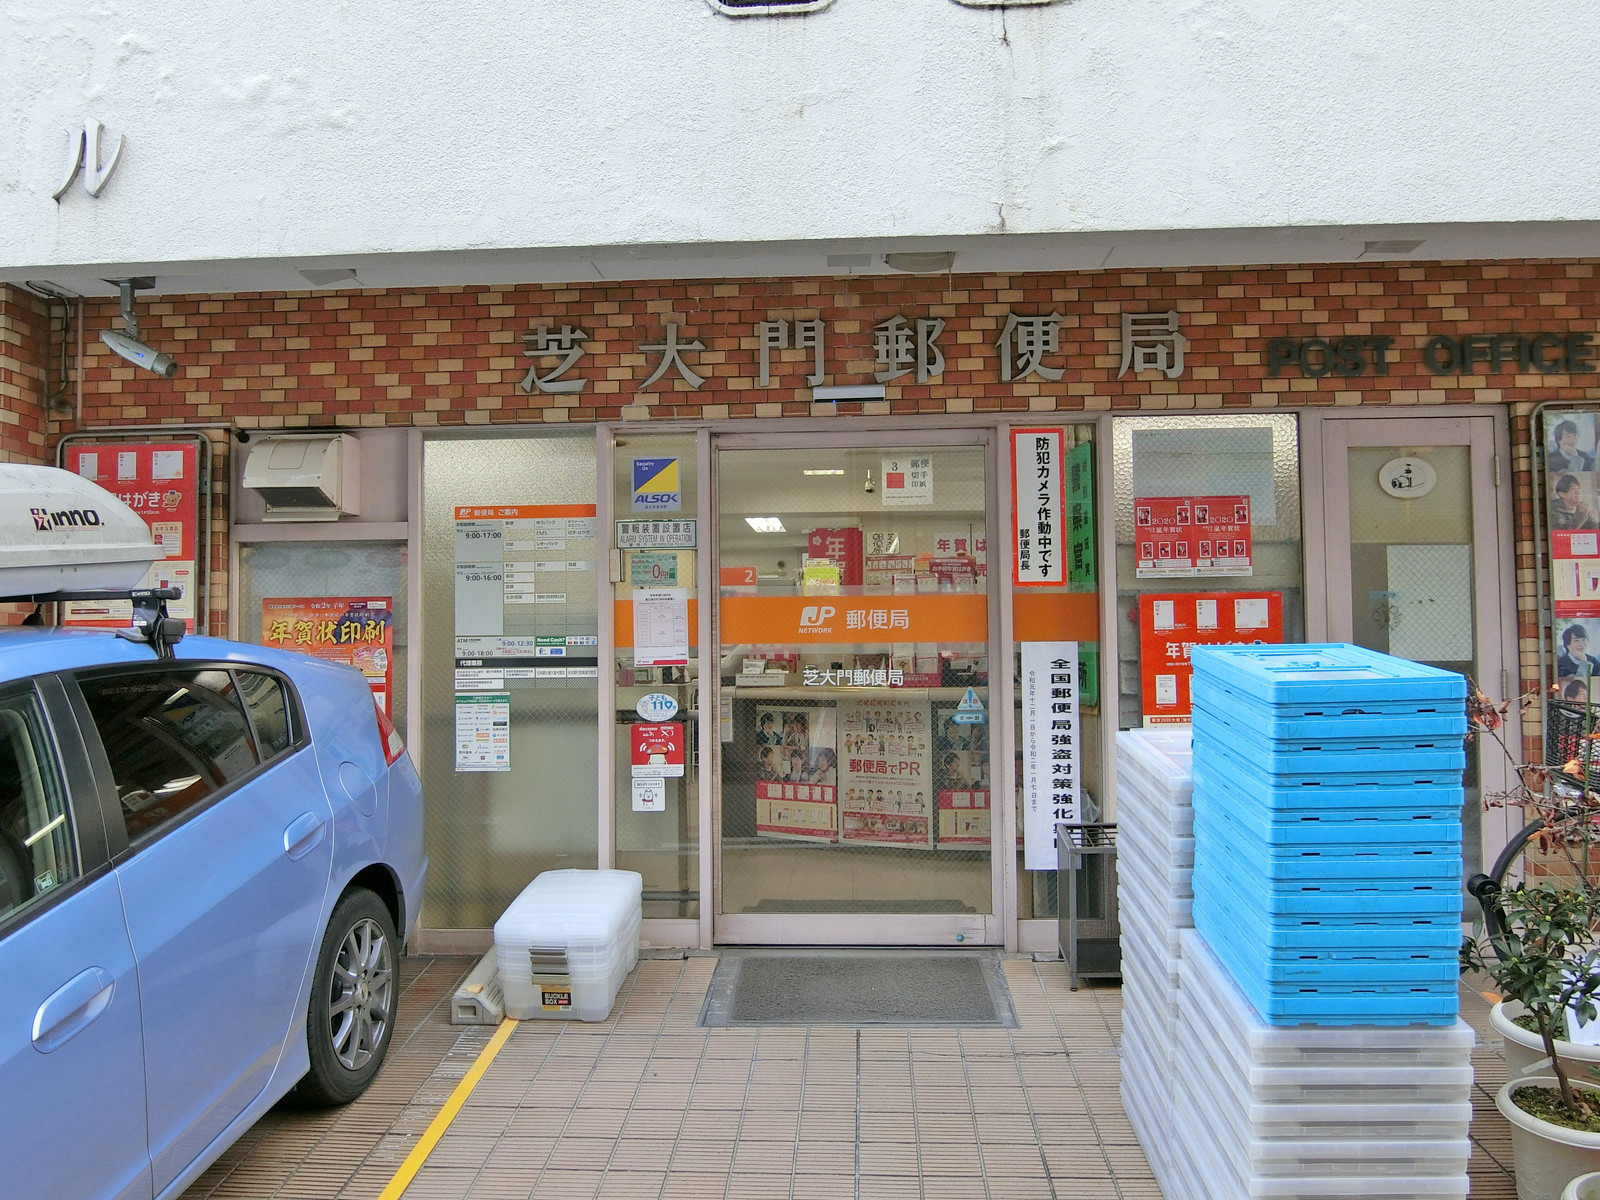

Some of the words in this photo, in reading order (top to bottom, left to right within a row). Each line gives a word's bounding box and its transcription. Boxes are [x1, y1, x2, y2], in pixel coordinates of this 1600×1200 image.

[52, 117, 127, 201] ル
[520, 309, 1187, 393] 芝大門郵便局
[1267, 337, 1396, 379] POST
[1423, 332, 1597, 377] OFFICE
[891, 461, 898, 471] 3
[910, 459, 930, 469] 郵便
[911, 471, 928, 479] 切手
[911, 480, 927, 488] 印紙
[634, 493, 678, 504] ALSOK
[1035, 437, 1052, 578] 防犯カメラ作動中です
[50, 508, 105, 527] inno.
[1152, 517, 1176, 525] 2020
[1209, 516, 1234, 524] 2020
[621, 523, 691, 534] 警報装置設置店
[620, 535, 637, 543] ALARM
[638, 534, 658, 543] SYSTEM
[660, 534, 665, 542] IN
[666, 533, 692, 542] OPERATION
[1019, 528, 1031, 571] 郵便局長
[744, 569, 753, 583] 2
[800, 606, 836, 626] JP
[846, 609, 909, 629] 郵便局
[269, 620, 386, 645] 年賀状印刷
[802, 669, 904, 686] 芝大門郵便局
[1028, 670, 1038, 812] 令和元年十二月一日から令和二年一月七日まで
[1050, 658, 1074, 848] 全国郵便局強盗対策強化
[849, 759, 921, 776] 郵便局でPR
